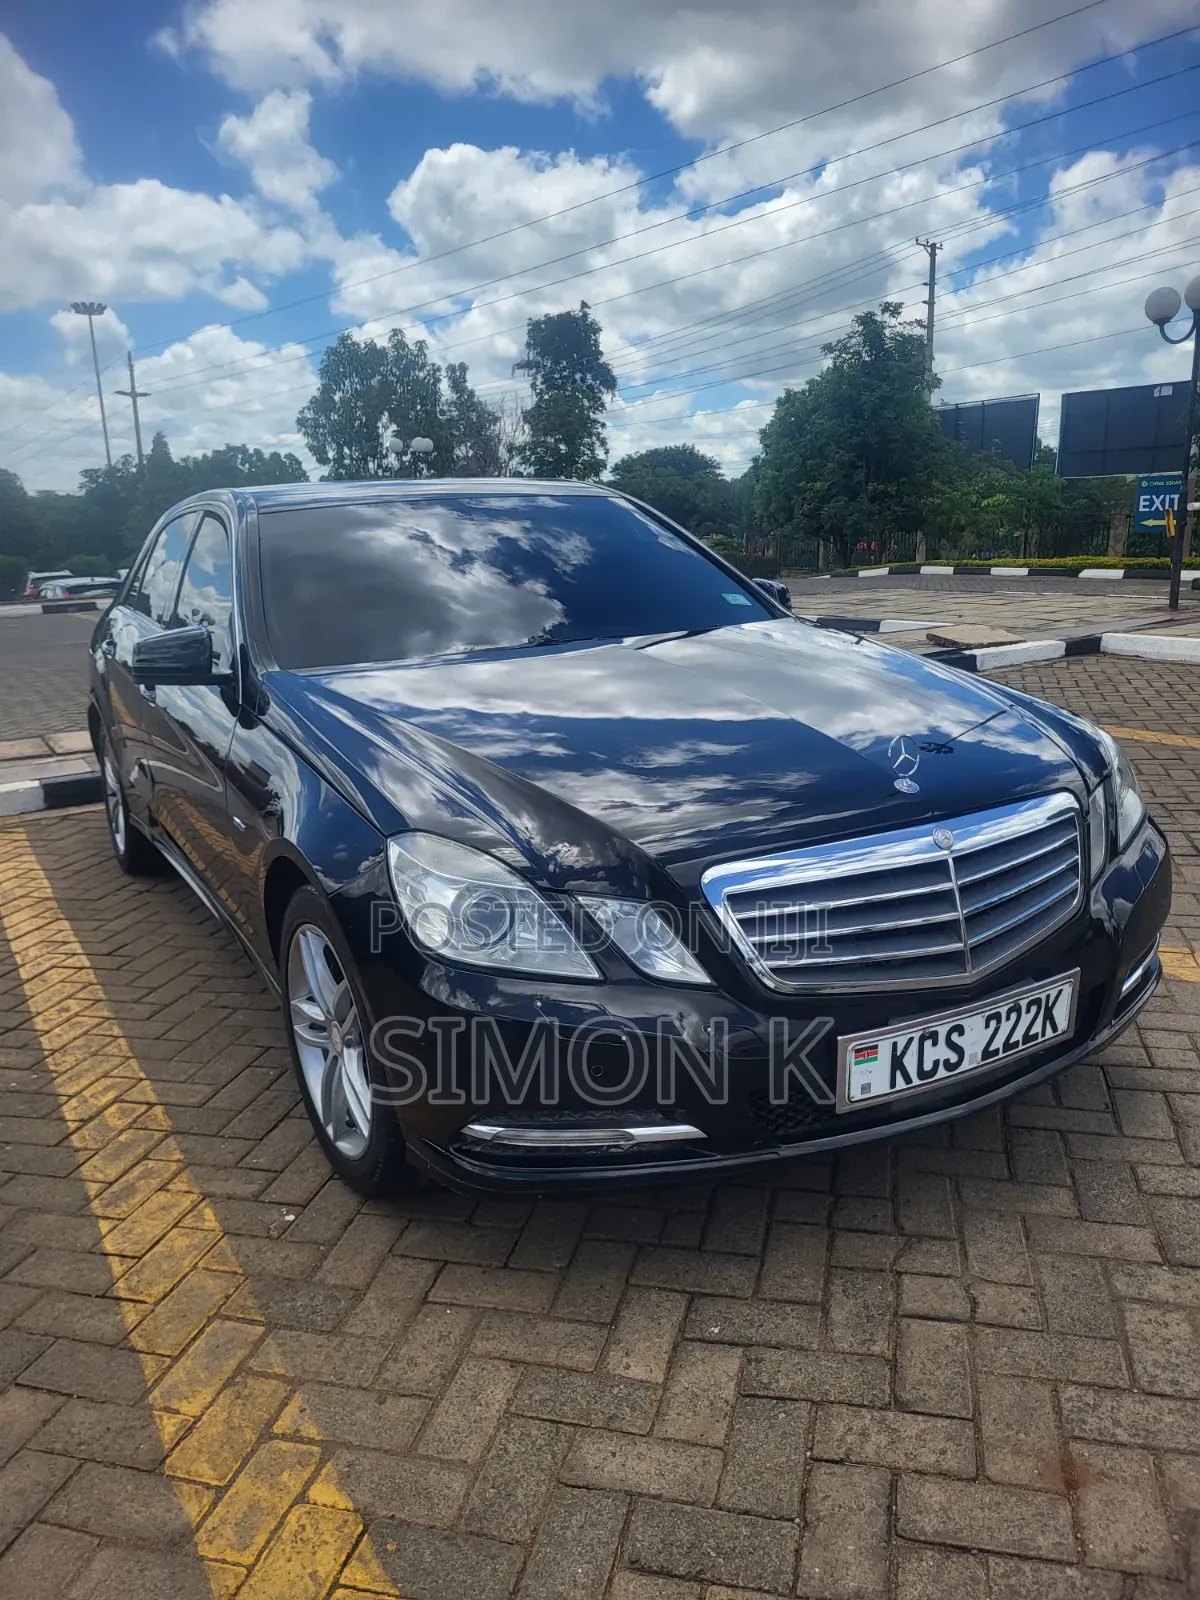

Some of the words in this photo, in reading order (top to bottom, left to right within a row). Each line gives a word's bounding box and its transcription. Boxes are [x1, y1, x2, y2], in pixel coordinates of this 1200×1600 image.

[1139, 494, 1180, 511] EXIT
[890, 1023, 966, 1089] KCS
[981, 988, 1064, 1061] 222K
